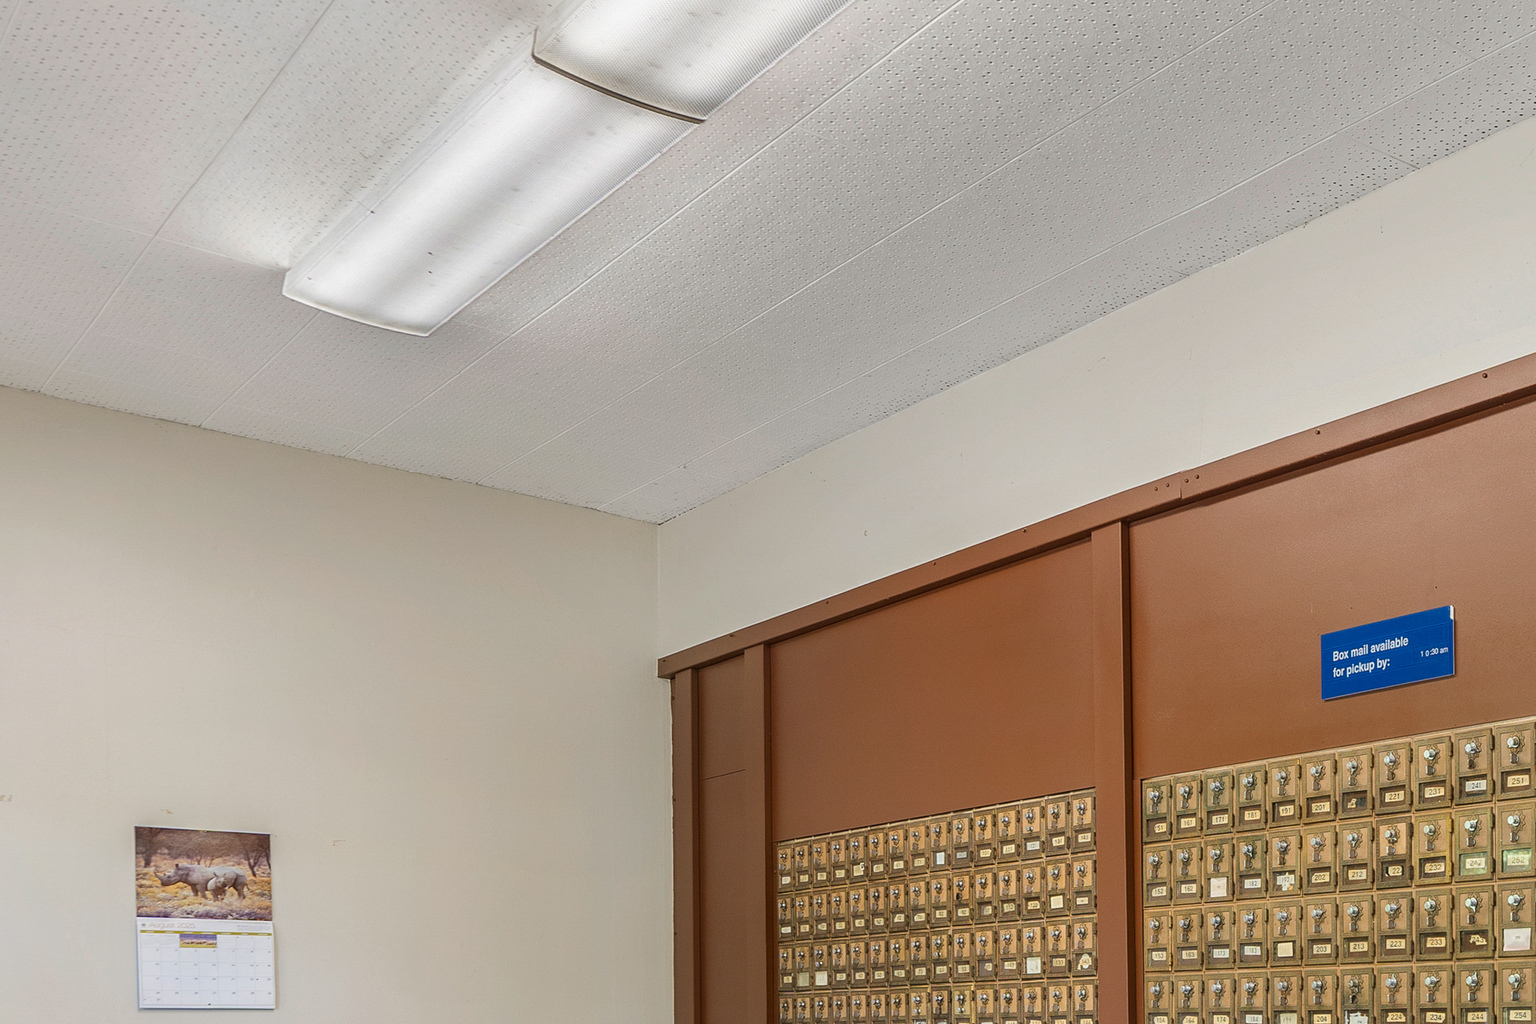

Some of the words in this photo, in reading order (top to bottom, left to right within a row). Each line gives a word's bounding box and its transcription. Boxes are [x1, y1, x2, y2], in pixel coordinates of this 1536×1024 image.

[1332, 650, 1349, 662] Box
[1350, 644, 1369, 658] mail
[1370, 635, 1409, 654] available
[1333, 666, 1345, 678] for
[1346, 658, 1375, 677] pickup
[1376, 657, 1391, 671] by:
